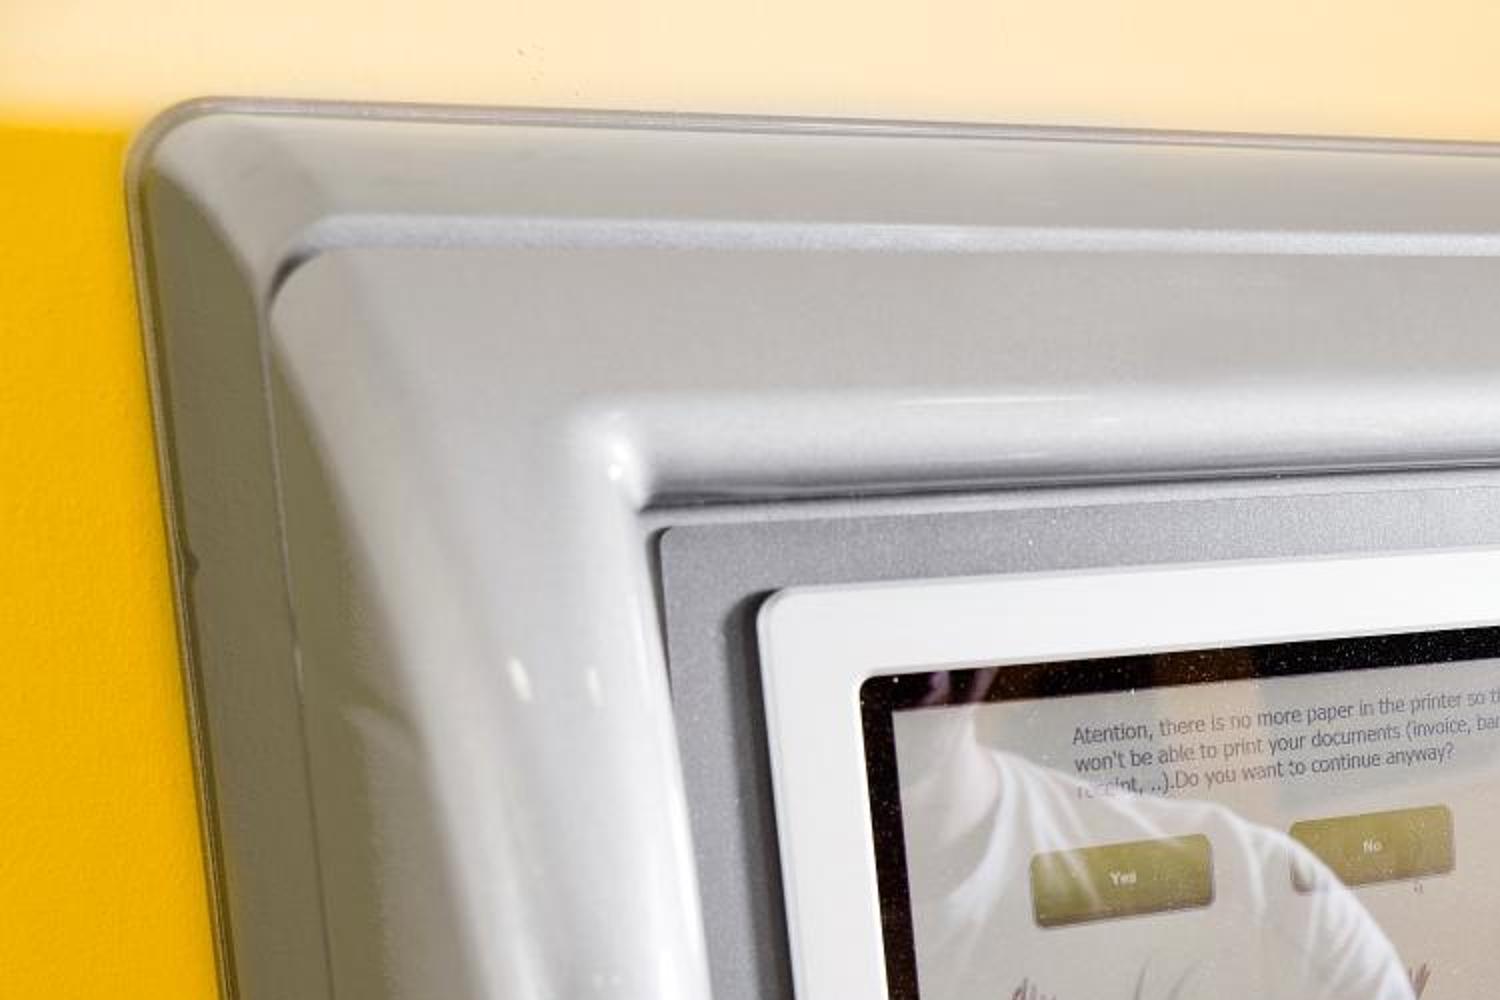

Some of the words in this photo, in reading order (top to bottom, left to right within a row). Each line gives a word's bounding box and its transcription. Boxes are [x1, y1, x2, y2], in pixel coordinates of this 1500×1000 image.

[1072, 722, 1153, 745] Atention,
[1158, 716, 1205, 737] there
[1211, 713, 1225, 731] is
[1230, 713, 1252, 730] no
[1257, 708, 1302, 727] more
[1307, 704, 1354, 726] paper
[1359, 698, 1374, 717] in
[1378, 697, 1405, 715] the
[1411, 692, 1461, 715] printer
[1467, 691, 1485, 707] so
[1074, 749, 1126, 773] won't
[1130, 750, 1152, 767] be
[1157, 743, 1195, 765] able
[1199, 743, 1217, 760] to
[1223, 736, 1263, 761] print
[1268, 735, 1306, 757] your
[1311, 727, 1401, 749] documents
[1405, 715, 1472, 743] (invoice,
[1205, 767, 1236, 790] you
[1241, 759, 1284, 782] want
[1288, 760, 1306, 777] to
[1311, 751, 1382, 774] continue
[1385, 740, 1455, 768] anyway?
[1363, 839, 1383, 854] No
[1109, 869, 1138, 887] Yes
